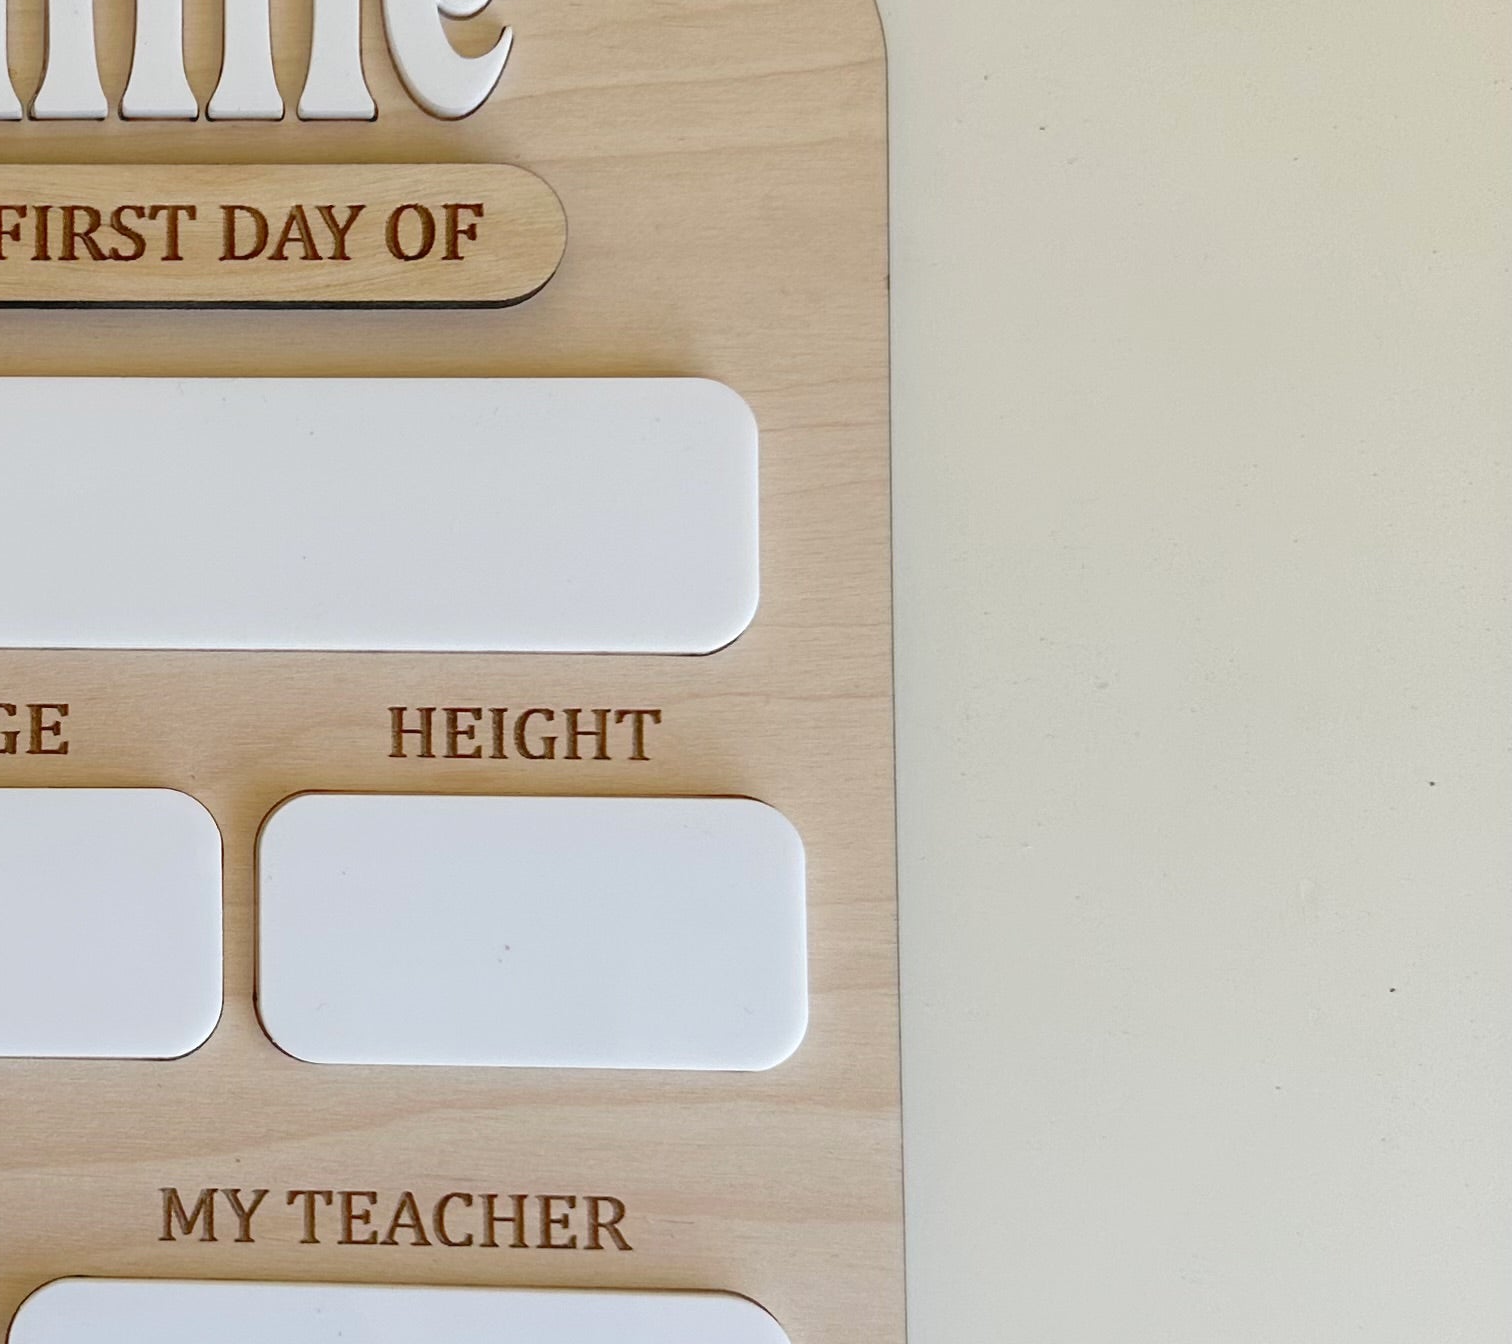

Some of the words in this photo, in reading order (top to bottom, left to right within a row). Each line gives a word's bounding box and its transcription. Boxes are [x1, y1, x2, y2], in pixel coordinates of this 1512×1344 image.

[217, 204, 368, 262] DAY
[384, 202, 485, 263] OF
[387, 706, 662, 762] HEIGHT
[157, 1187, 271, 1245] MY
[286, 1189, 634, 1252] TEACHER
